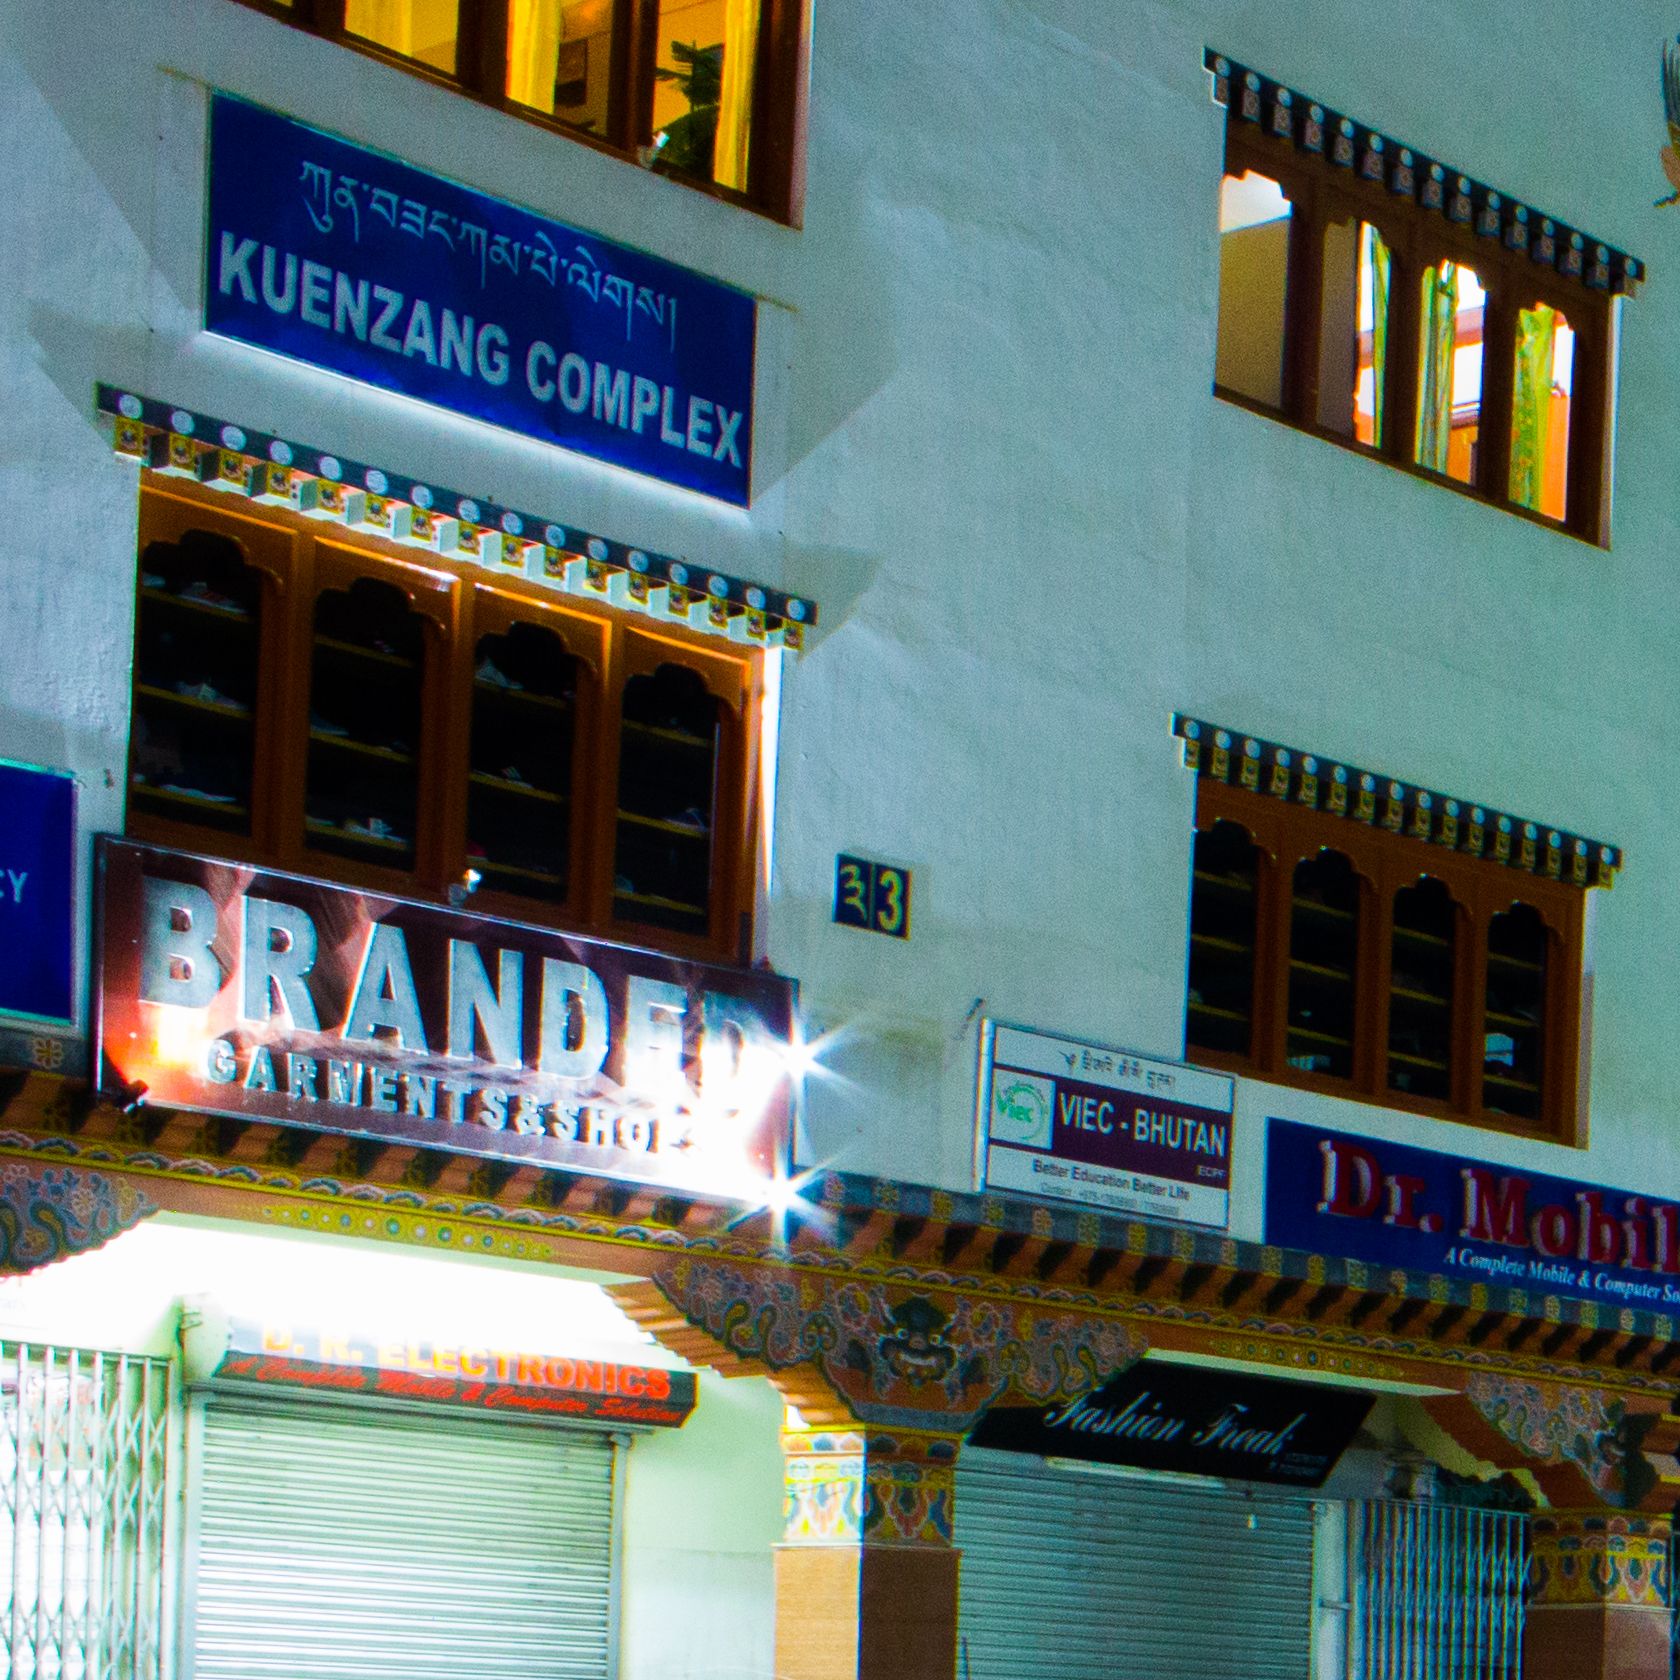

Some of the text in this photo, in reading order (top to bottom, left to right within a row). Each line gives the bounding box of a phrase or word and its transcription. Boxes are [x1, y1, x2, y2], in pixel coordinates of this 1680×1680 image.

[218, 230, 744, 469] KUENZANG COMPLEX
[878, 870, 902, 931] 3
[139, 876, 758, 1108] BRANDED
[1060, 1092, 1115, 1134] VIEC
[1134, 1108, 1227, 1157] BHUTAN
[1032, 1158, 1068, 1178] Better
[1071, 1166, 1130, 1189] Education
[1132, 1177, 1168, 1196] Better
[1317, 1139, 1443, 1232] Dr.
[1444, 1247, 1457, 1265] A
[1459, 1248, 1525, 1279] Complete
[1528, 1260, 1575, 1286] Mobile
[1578, 1269, 1591, 1288] &
[1594, 1272, 1660, 1301] Computer
[378, 1341, 671, 1399] ELECTRONICS
[1044, 1388, 1307, 1456] Fashion Freak
